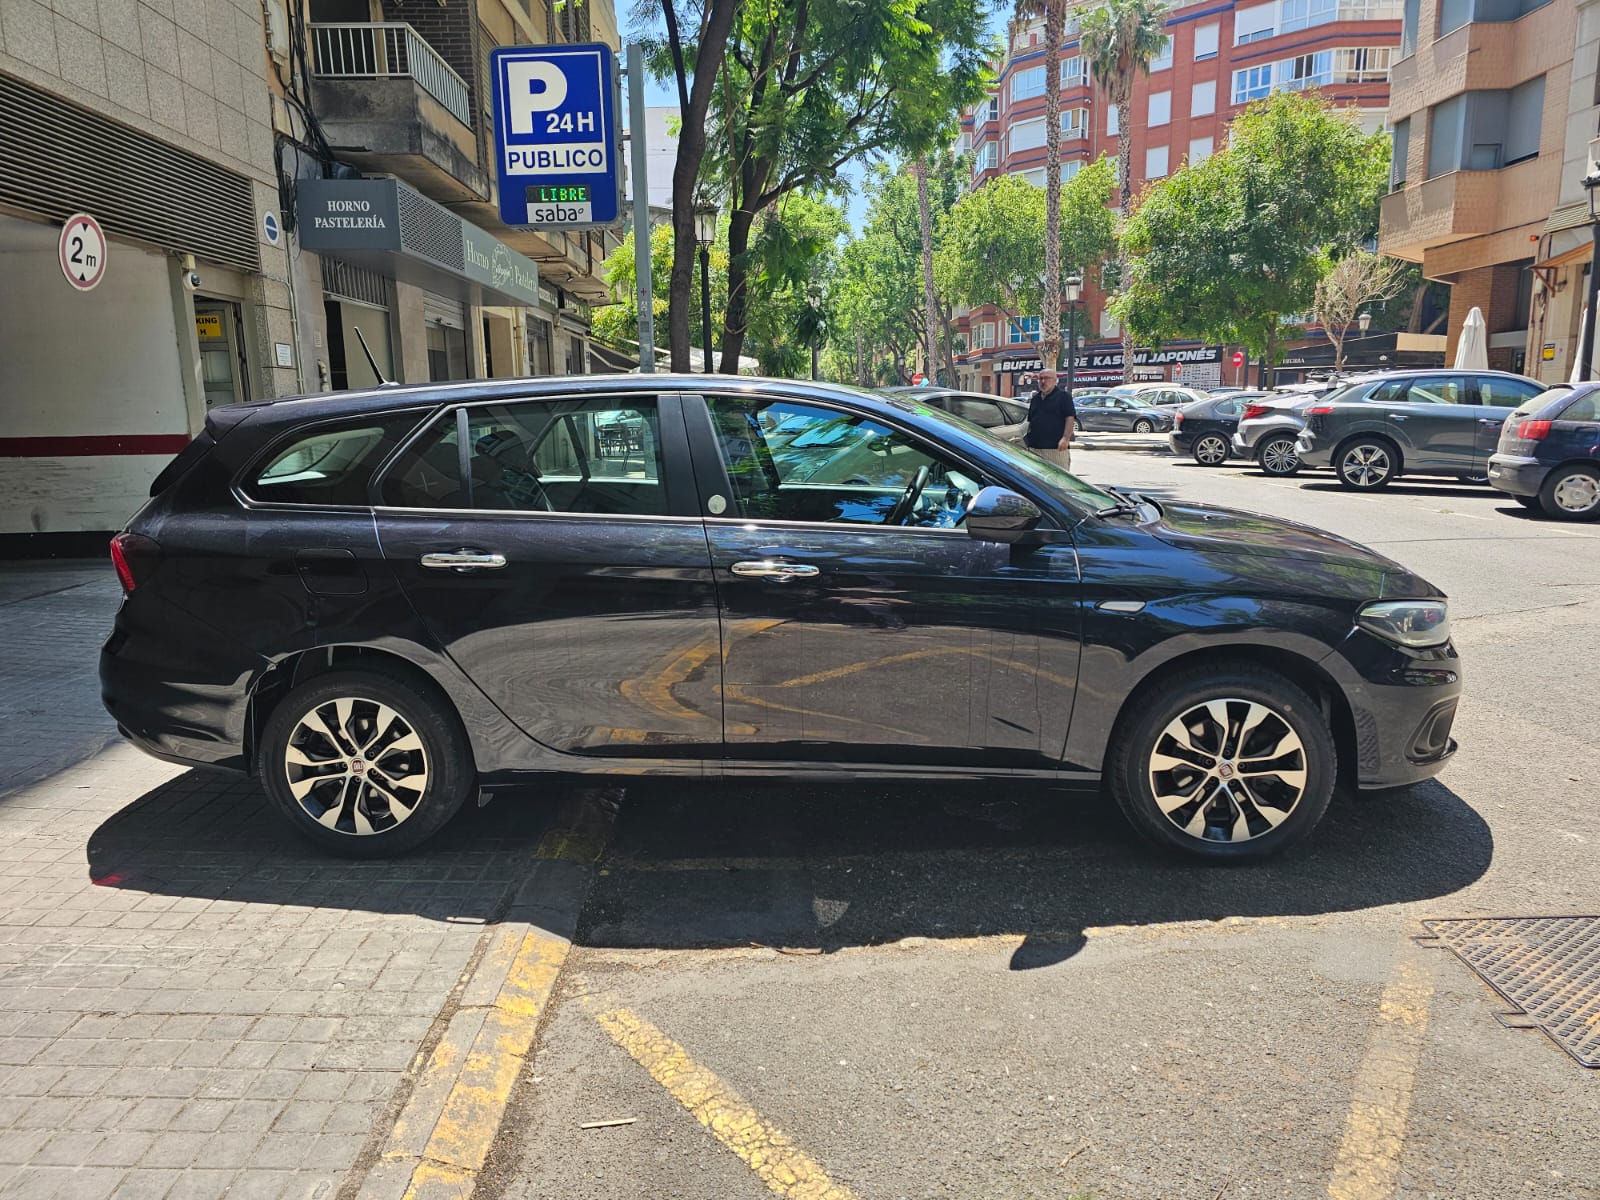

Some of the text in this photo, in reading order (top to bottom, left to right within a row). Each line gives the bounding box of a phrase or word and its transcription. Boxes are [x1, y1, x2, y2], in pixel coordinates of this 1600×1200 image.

[507, 61, 567, 134] P
[508, 149, 603, 169] PUBLICO
[540, 187, 586, 202] LIBRE
[327, 200, 370, 211] HORNO
[314, 214, 386, 228] PASTELERÍA
[71, 236, 83, 264] 2
[1002, 359, 1045, 371] BUFFE
[1149, 347, 1217, 363] JAPONÉS
